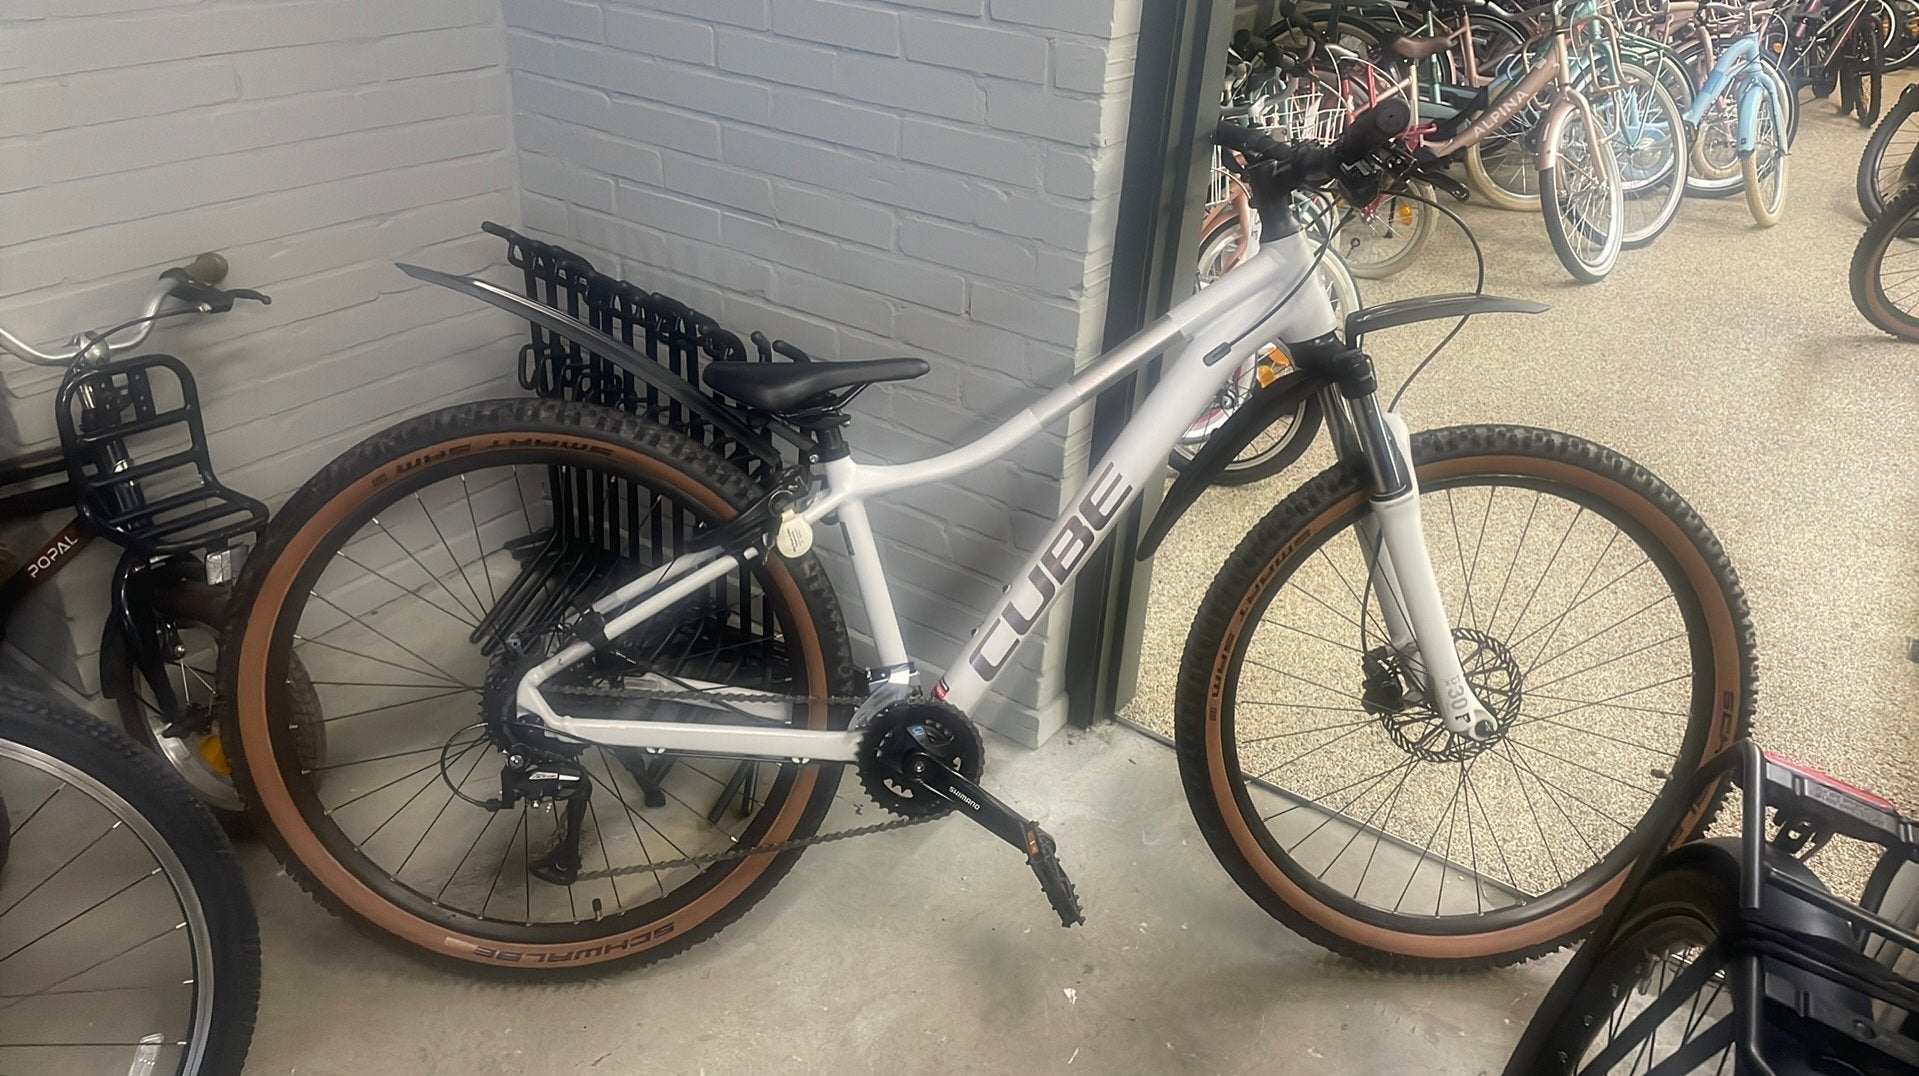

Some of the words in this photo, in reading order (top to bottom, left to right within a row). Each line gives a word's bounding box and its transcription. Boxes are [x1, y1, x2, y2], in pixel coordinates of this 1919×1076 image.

[1474, 90, 1529, 138] ALPINA
[395, 443, 473, 474] SAM
[486, 438, 616, 456] SMART
[27, 535, 79, 578] POPAL
[968, 461, 1134, 682] CUBE
[1448, 685, 1467, 709] 30
[948, 785, 981, 811] SHIMANO
[473, 921, 676, 963] SCHWALBE
